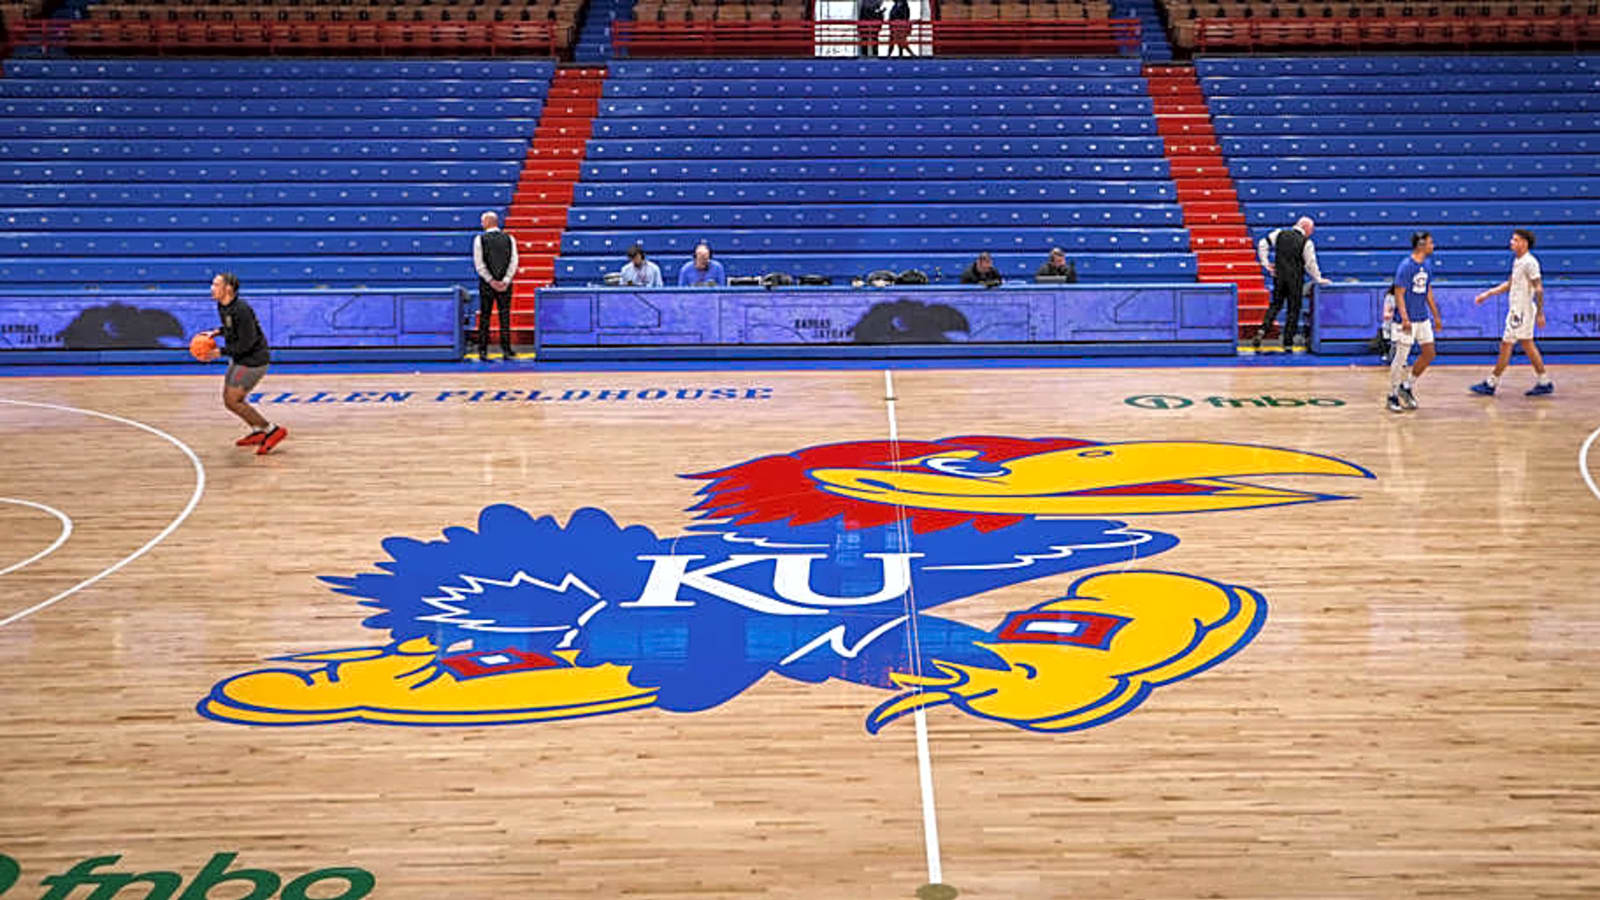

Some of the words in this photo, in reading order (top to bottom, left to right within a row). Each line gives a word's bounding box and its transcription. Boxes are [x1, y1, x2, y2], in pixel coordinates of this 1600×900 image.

[435, 387, 774, 402] FIELDHOUSE
[1206, 395, 1347, 409] fnbo
[619, 552, 925, 616] KU
[39, 851, 375, 900] fnbo
